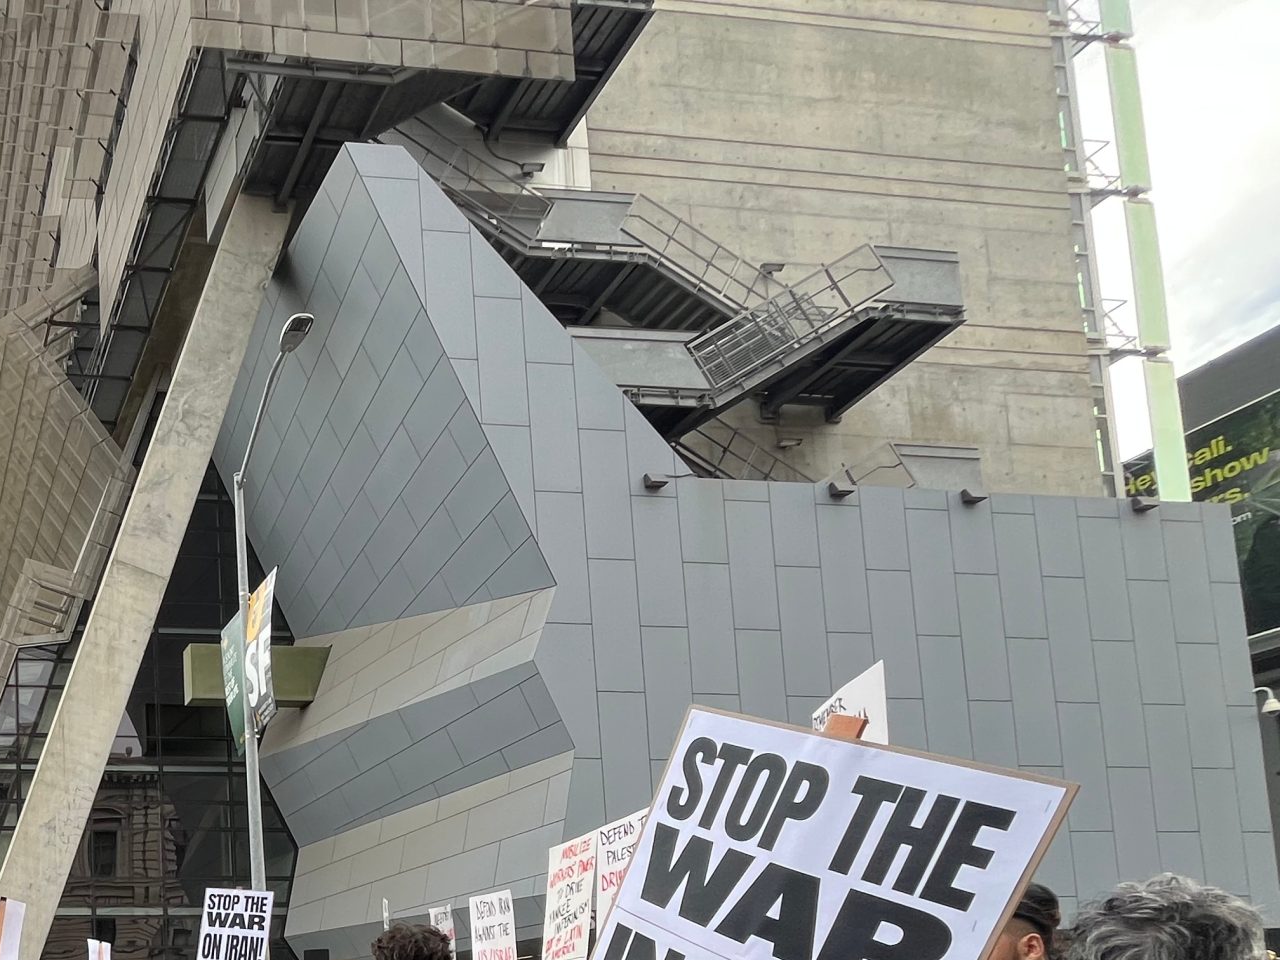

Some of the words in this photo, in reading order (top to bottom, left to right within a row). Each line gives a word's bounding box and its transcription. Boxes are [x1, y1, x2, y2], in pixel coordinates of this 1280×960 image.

[1187, 435, 1233, 467] ali.
[1191, 446, 1270, 493] show
[600, 821, 635, 846] DEFEND
[666, 736, 830, 852] STOP
[827, 775, 1017, 912] THE
[208, 893, 240, 911] STOP
[244, 895, 268, 913] THE
[207, 911, 266, 931] WAR
[201, 933, 223, 960] ON
